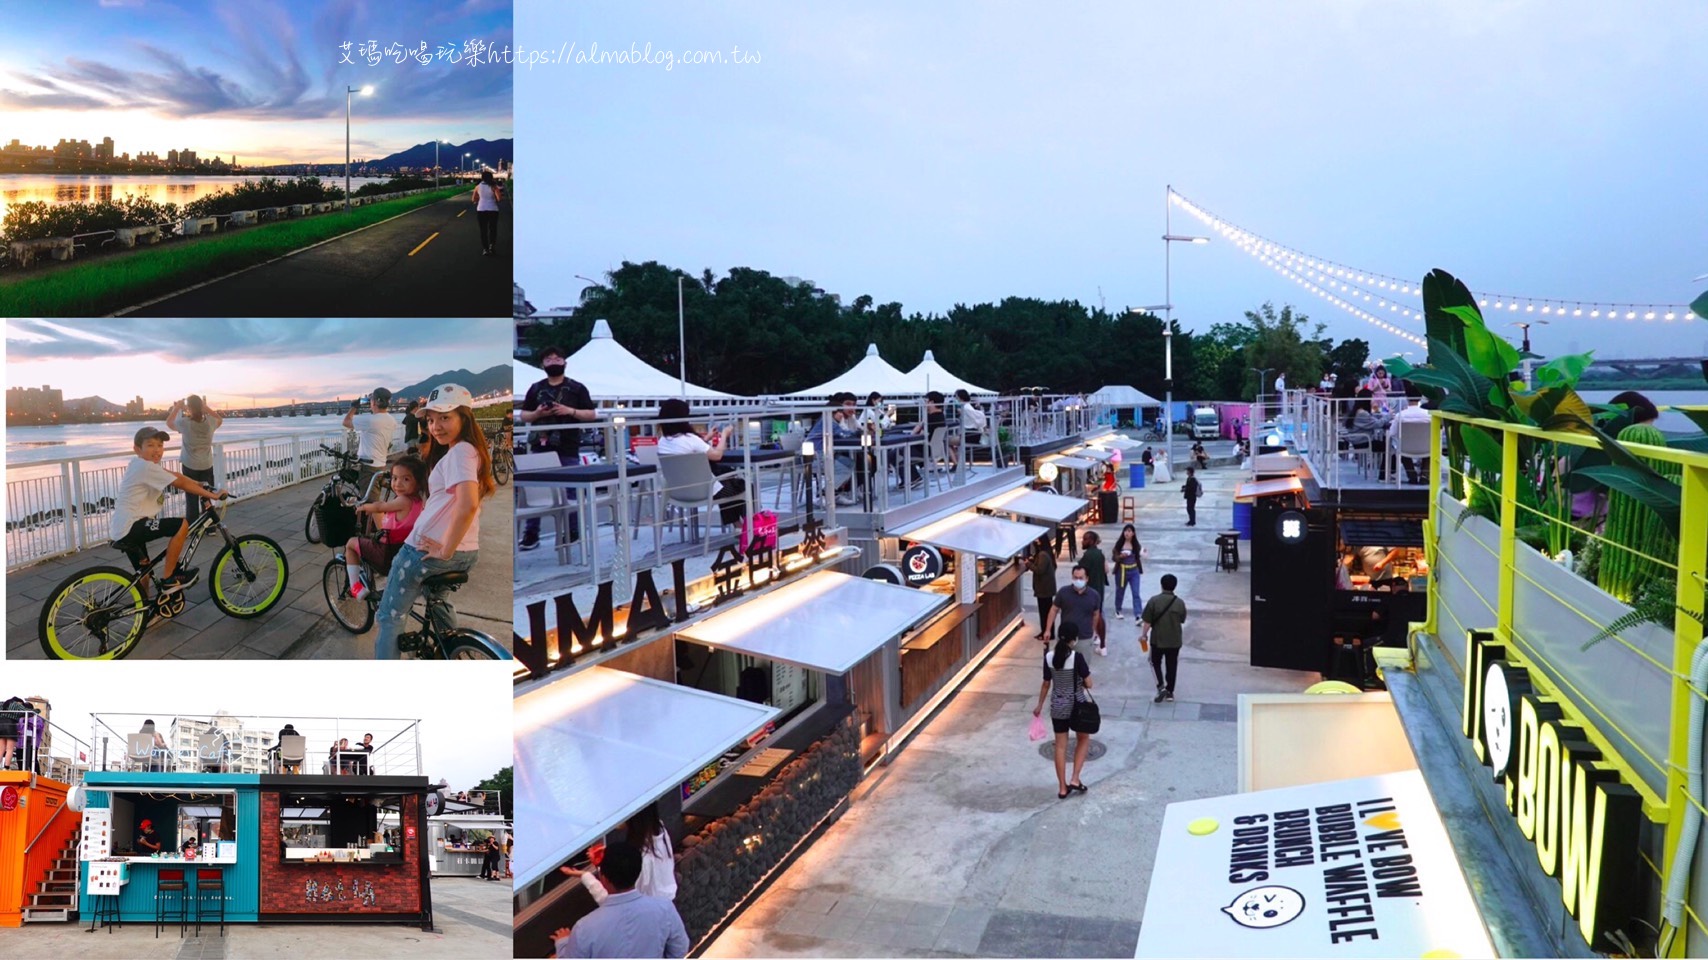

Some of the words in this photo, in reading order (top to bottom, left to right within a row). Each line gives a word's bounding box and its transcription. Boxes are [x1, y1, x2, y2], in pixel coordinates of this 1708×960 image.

[908, 573, 924, 581] PIZZA
[925, 572, 935, 580] LAB
[1233, 813, 1269, 825] &
[1357, 797, 1393, 806] I
[1516, 696, 1607, 948] BOW
[1228, 825, 1269, 883] DRINKS
[1273, 808, 1315, 868] BRUNCH
[1315, 803, 1361, 862] BUBBLE
[1323, 863, 1379, 944] WAFFLE
[1370, 854, 1423, 898] BOW
